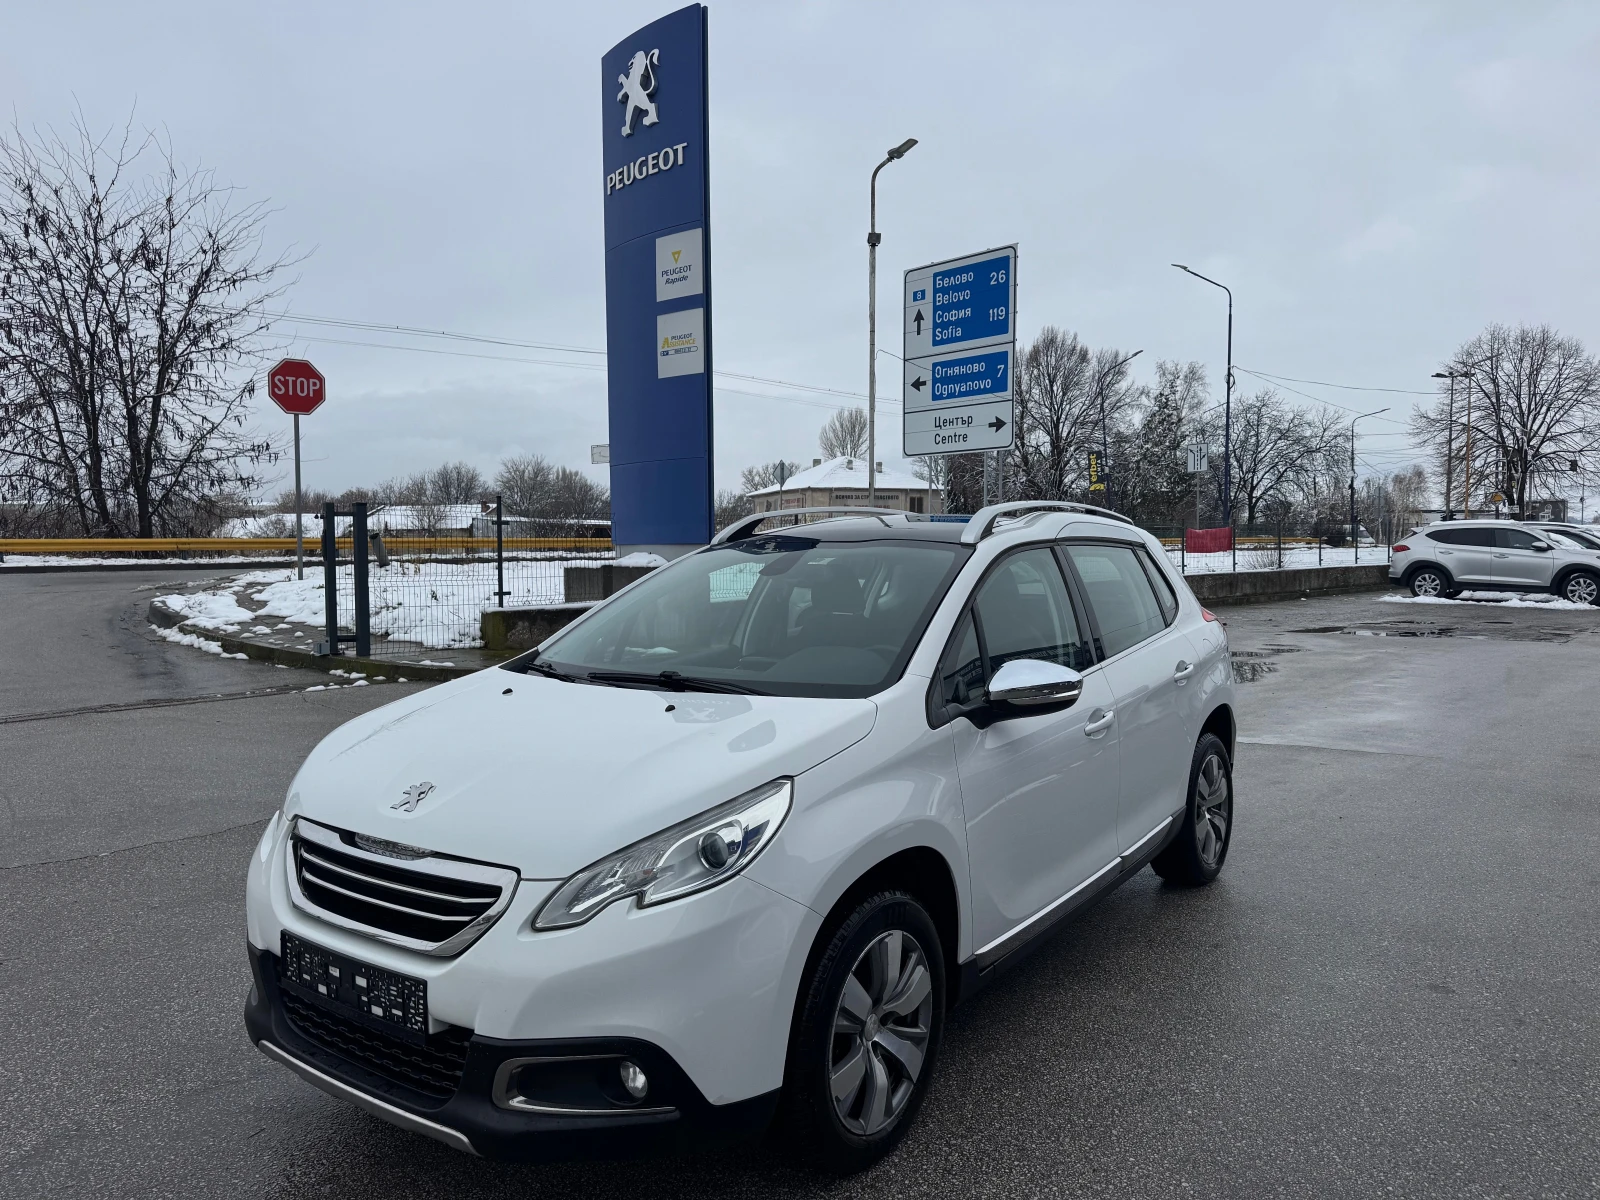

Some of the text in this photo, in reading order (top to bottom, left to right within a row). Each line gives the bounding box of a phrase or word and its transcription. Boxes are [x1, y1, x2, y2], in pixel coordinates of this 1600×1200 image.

[607, 142, 688, 195] PEUGEOT
[661, 264, 692, 277] PEUGEOT
[665, 275, 688, 285] Rapide
[936, 269, 1006, 289] Белово 26
[936, 290, 971, 306] Belovo
[935, 306, 1006, 323] София 119
[671, 333, 693, 341] PEUGEOT
[935, 325, 962, 341] Sofia
[935, 362, 1005, 378] Огняново 7
[274, 375, 320, 398] STOP
[935, 379, 992, 398] Ognyanovo
[934, 415, 973, 430] Център
[934, 432, 968, 445] Centre
[1090, 454, 1098, 482] efbet
